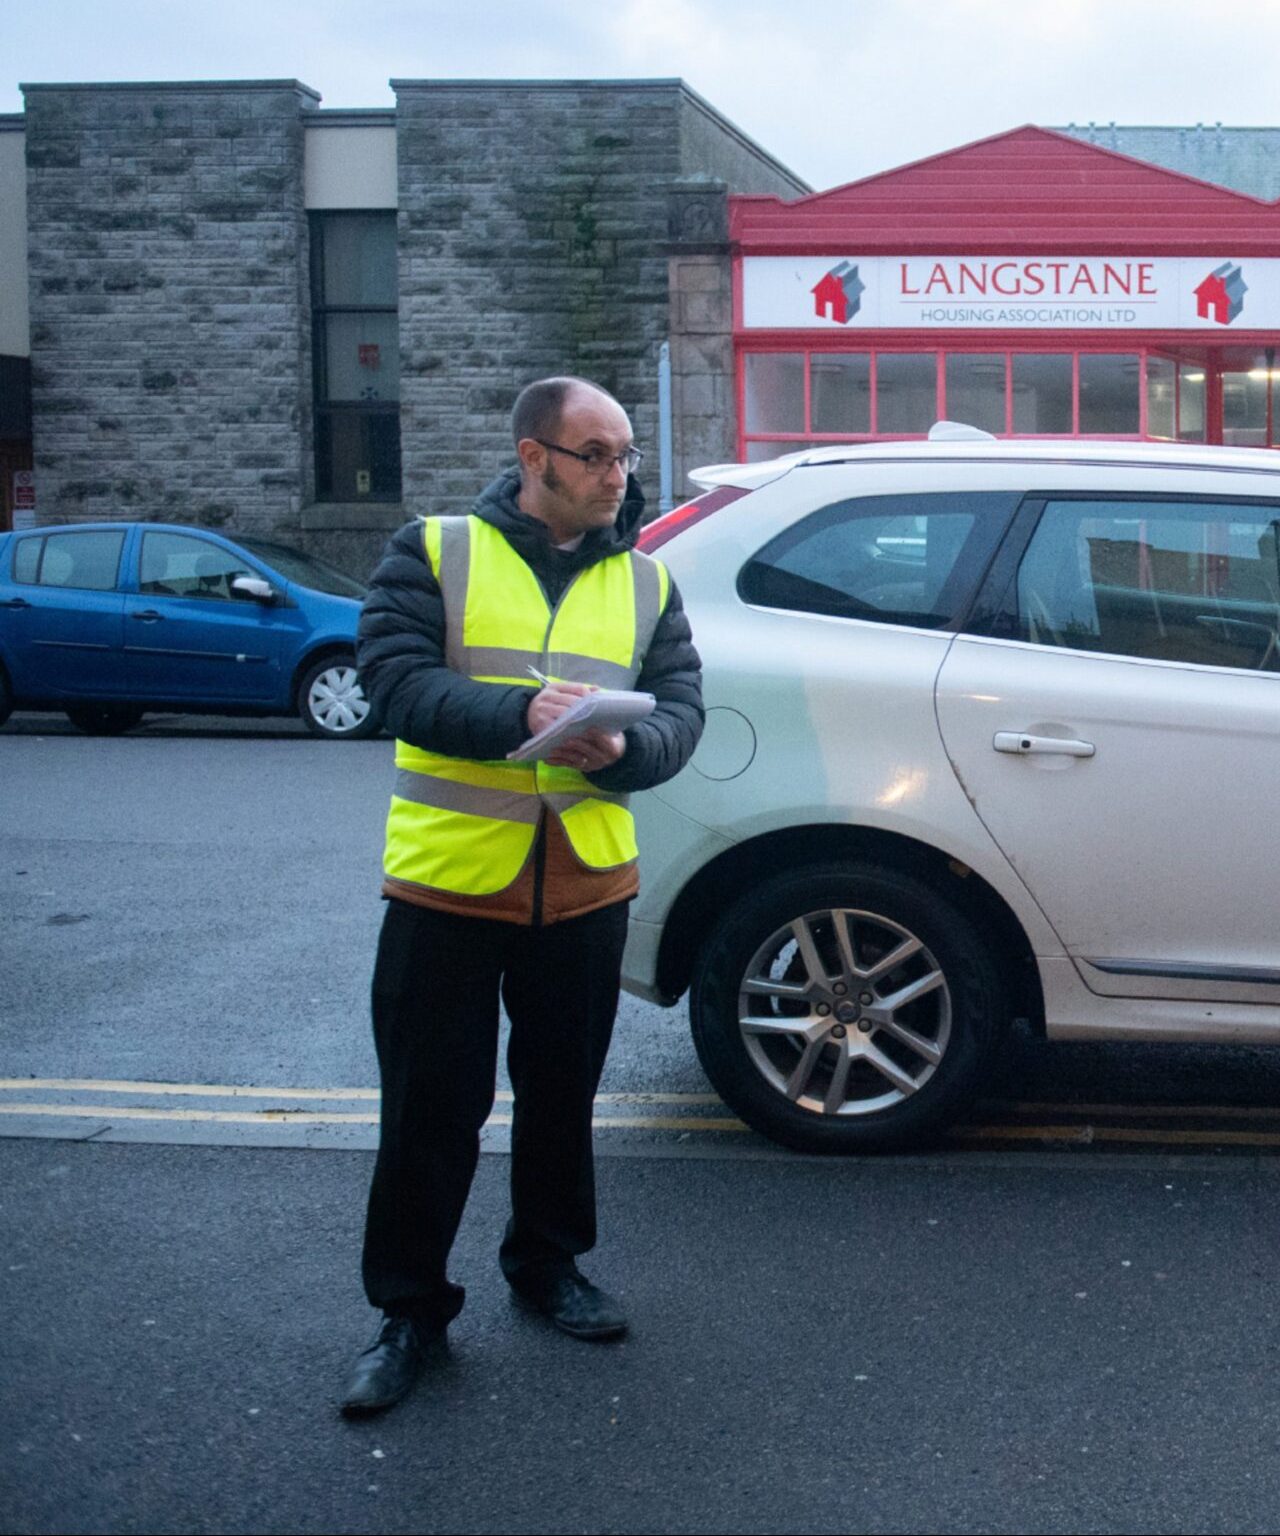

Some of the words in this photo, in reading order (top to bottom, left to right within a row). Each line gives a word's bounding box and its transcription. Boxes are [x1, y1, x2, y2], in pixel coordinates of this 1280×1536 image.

[901, 263, 1157, 295] LANGSTANE
[921, 308, 994, 322] HOUSING
[999, 308, 1102, 322] ASSOCIATION
[1107, 309, 1136, 322] LTD
